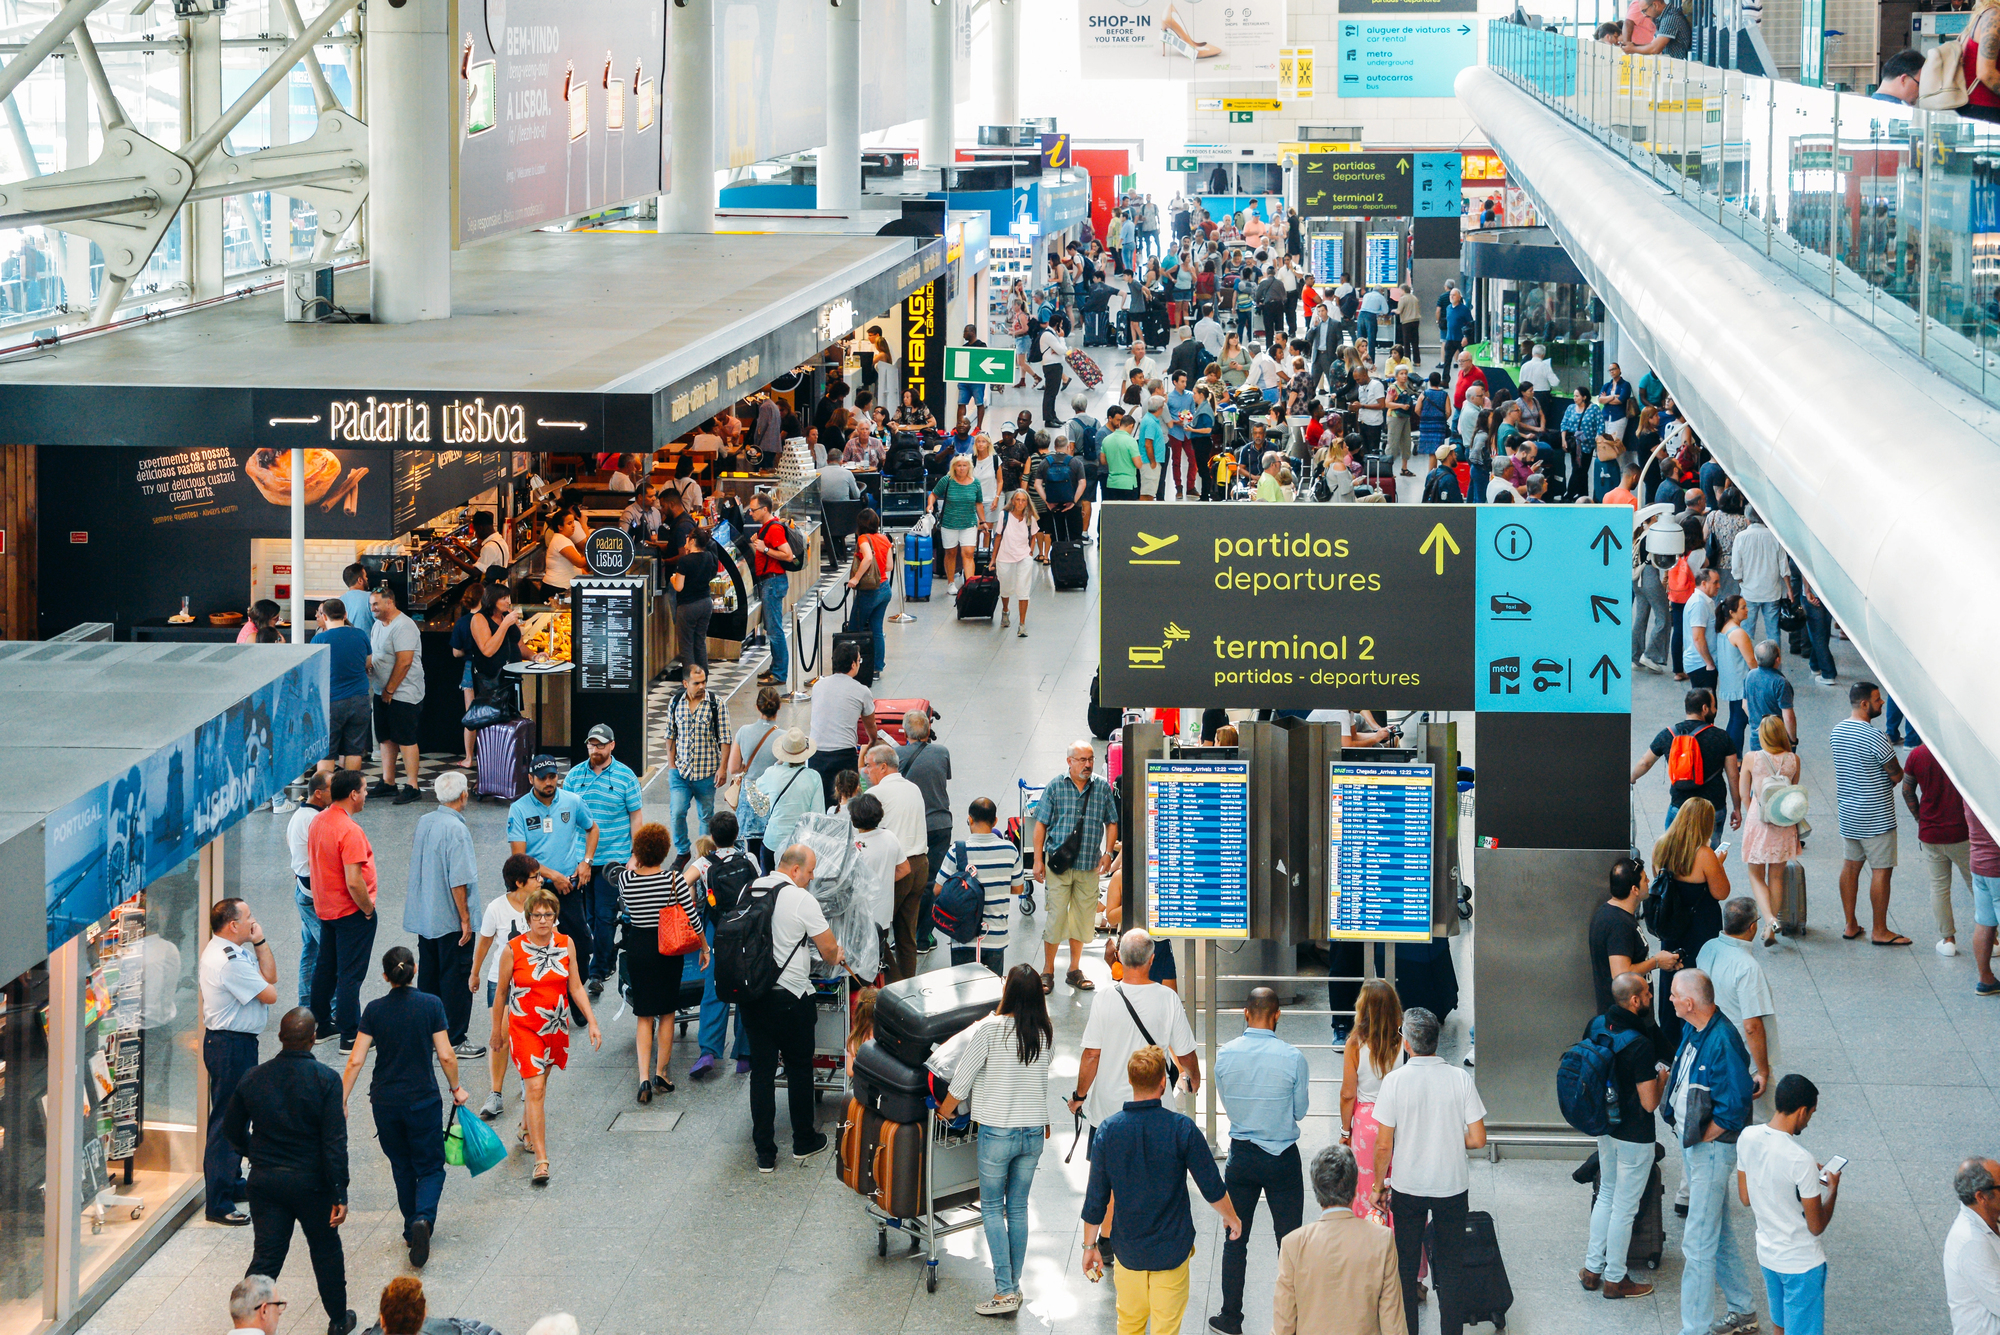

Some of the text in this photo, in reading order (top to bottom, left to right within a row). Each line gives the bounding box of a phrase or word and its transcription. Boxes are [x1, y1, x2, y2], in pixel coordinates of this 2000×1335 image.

[1089, 15, 1150, 27] SHOP-IN
[1367, 26, 1399, 35] aluguer
[507, 26, 559, 56] BEM-VINDO
[507, 88, 551, 120] A LISBOA.
[1333, 161, 1376, 172] partidas
[1333, 172, 1385, 182] departures
[1333, 193, 1383, 202] terminal 2
[207, 459, 217, 470] de
[172, 476, 206, 492] delicious
[208, 471, 236, 484] custard
[169, 490, 193, 503] cream
[1214, 532, 1349, 563] partidas
[1214, 566, 1381, 596] departures
[1213, 634, 1374, 660] terminal 2
[1214, 669, 1293, 687] partidas
[1310, 669, 1420, 688] departures
[304, 735, 330, 762] PORTUG
[534, 760, 555, 770] POLÍCIA
[194, 767, 255, 836] LISBON
[53, 802, 102, 846] PORTUGAL
